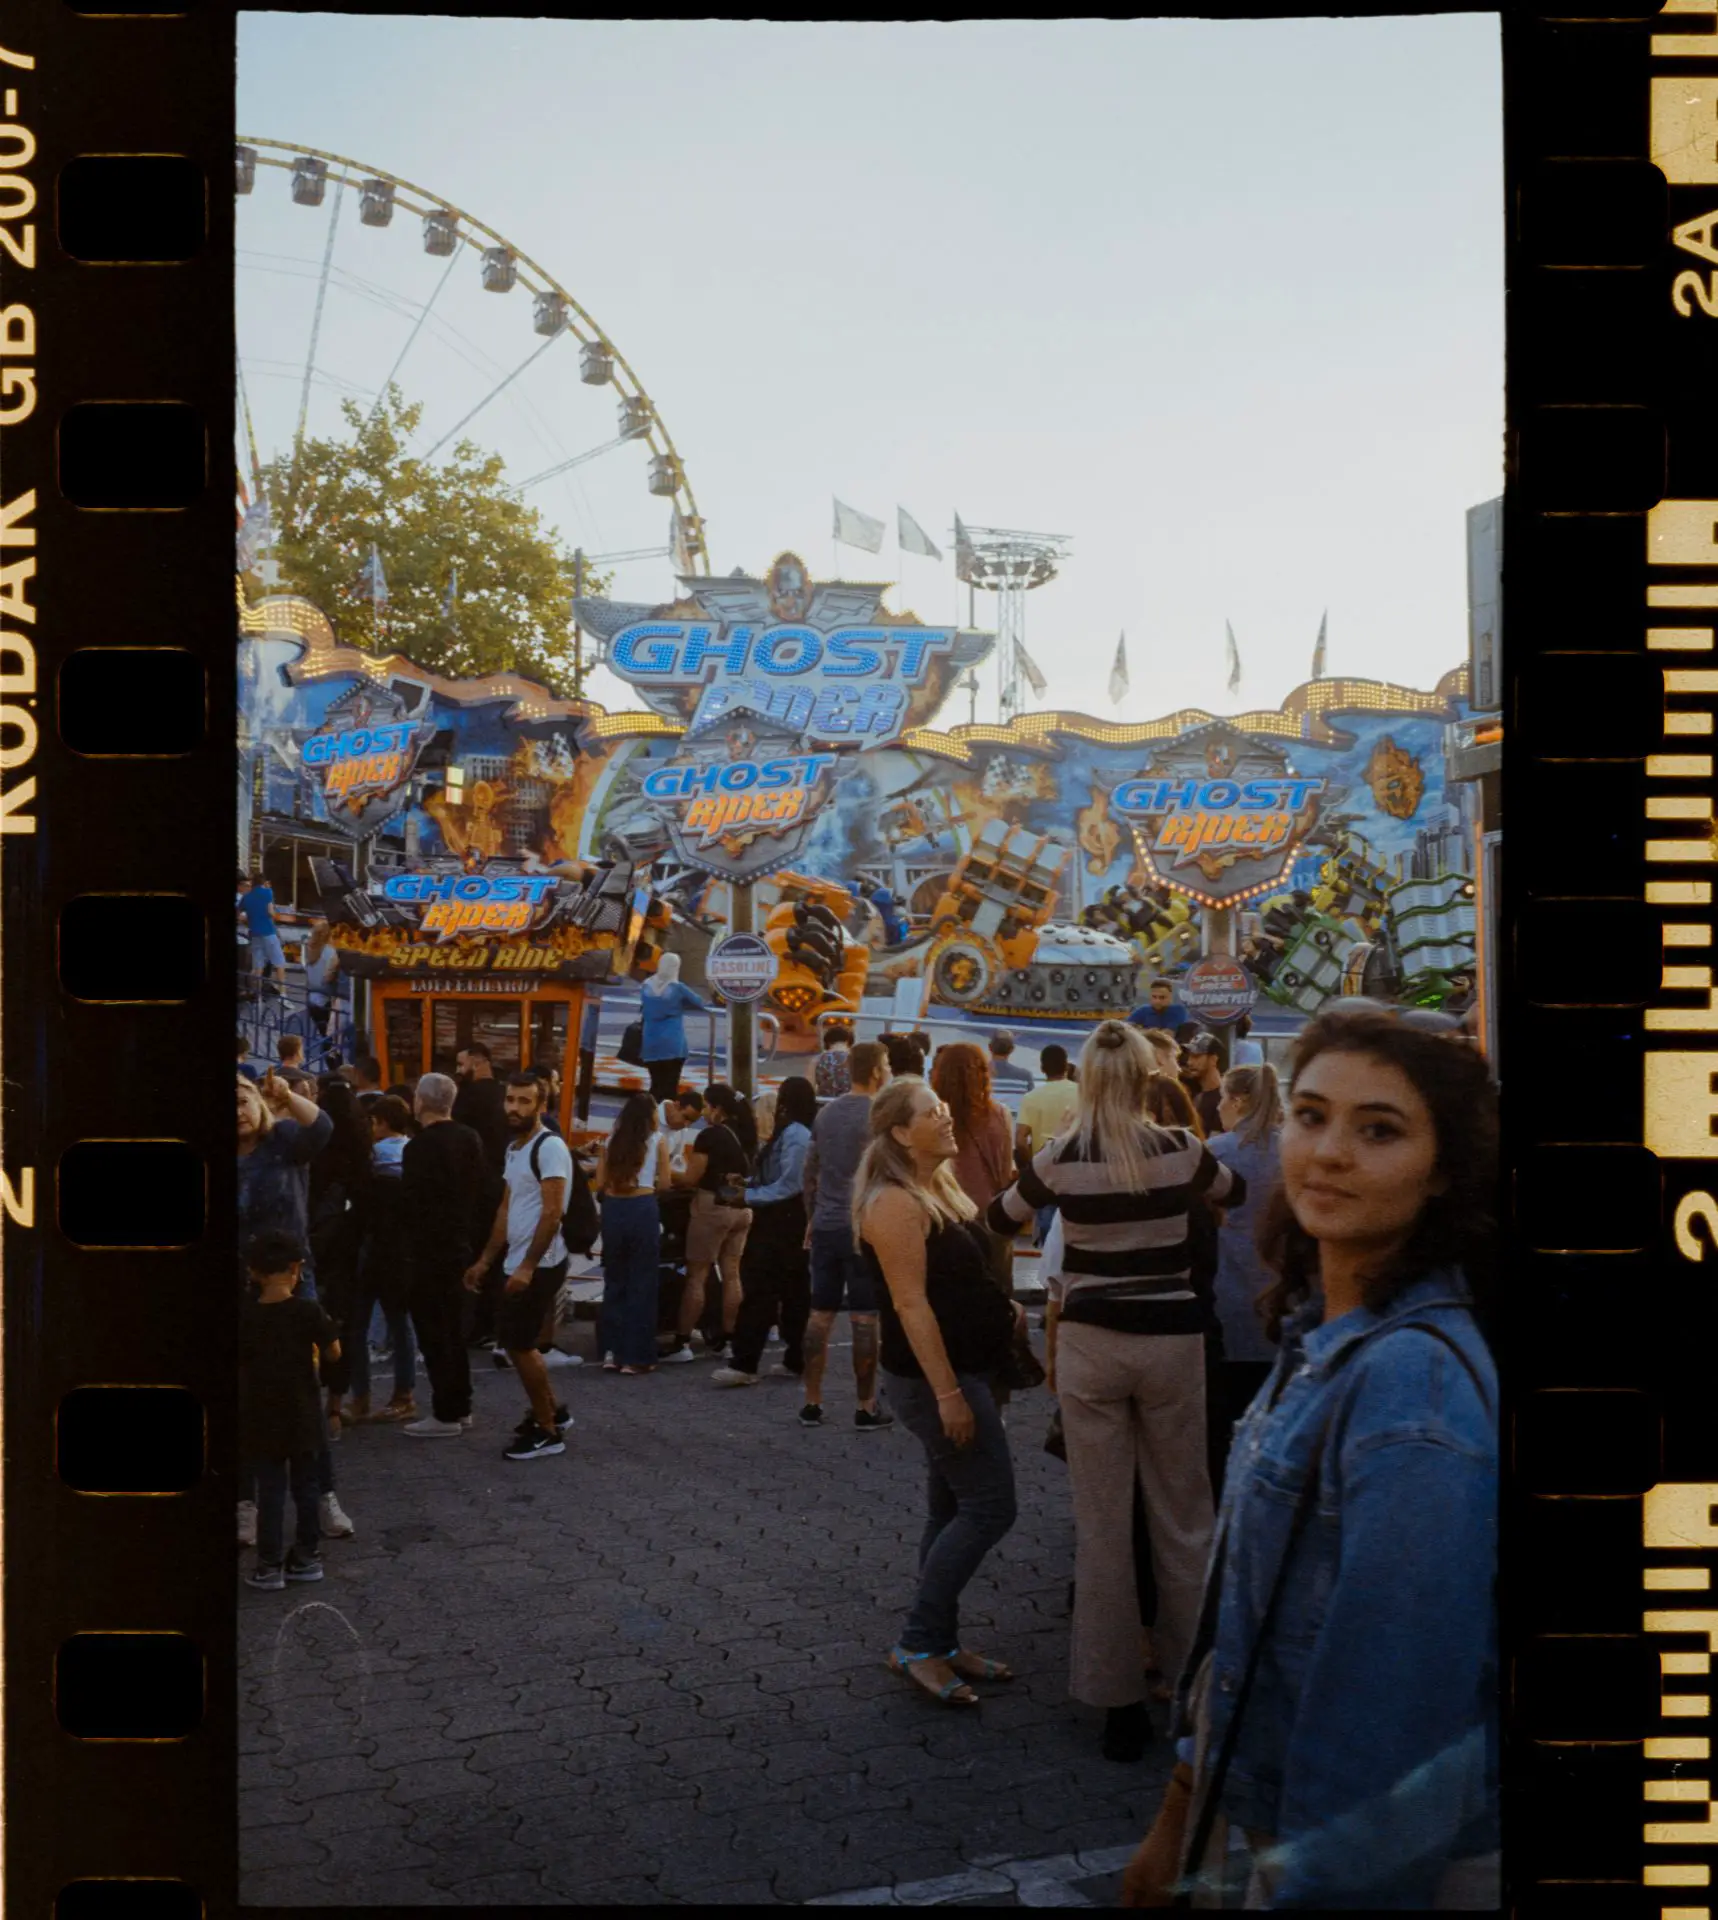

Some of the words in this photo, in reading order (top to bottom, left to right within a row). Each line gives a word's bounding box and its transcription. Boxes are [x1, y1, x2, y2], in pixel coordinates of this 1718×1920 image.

[1673, 209, 1718, 318] 2A
[612, 624, 946, 677] GHOST
[303, 720, 417, 763] GHOST
[327, 754, 400, 796] RIDER
[643, 754, 834, 796] GHOST
[1113, 778, 1321, 810] GHOST
[687, 790, 805, 836] RIDER
[1159, 812, 1290, 854] RIDER
[384, 874, 558, 901] GHOST
[425, 901, 532, 937] RIDER
[389, 946, 490, 969] SPEED
[491, 942, 563, 970] RIDE
[710, 960, 773, 976] GASOLINE
